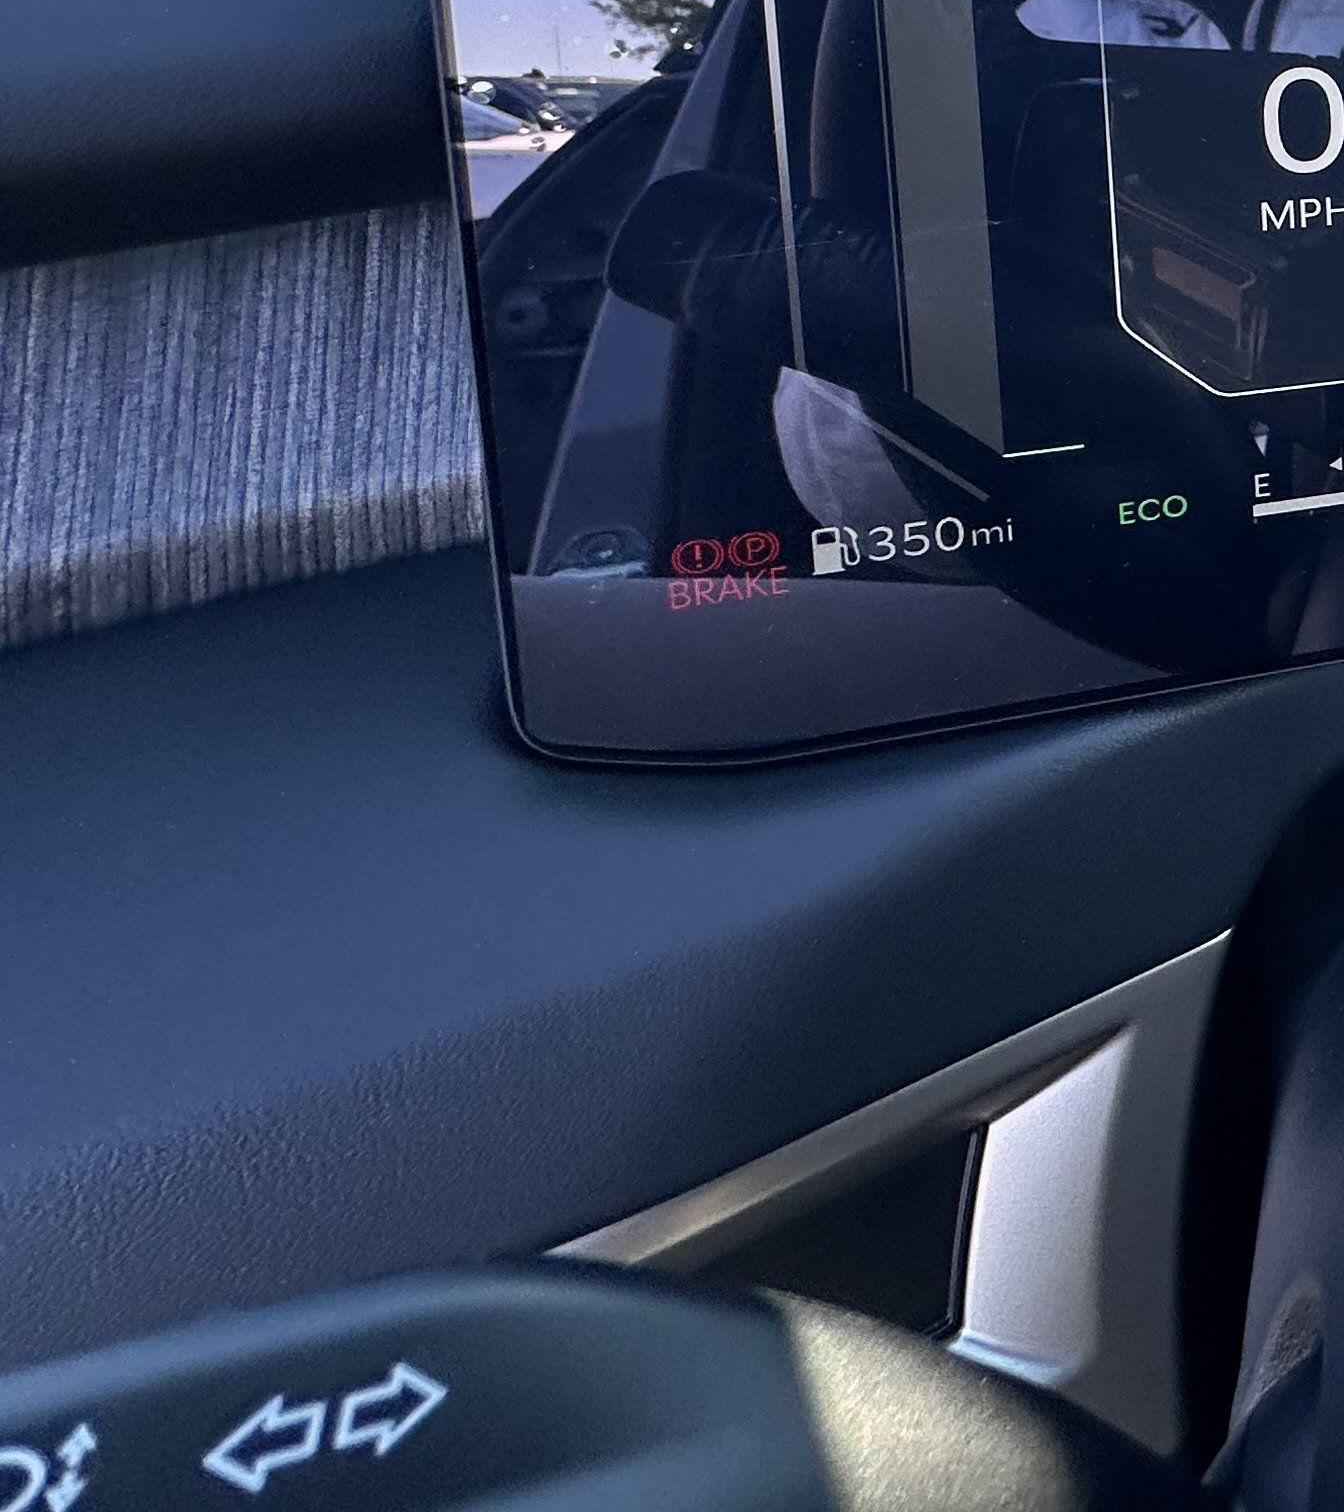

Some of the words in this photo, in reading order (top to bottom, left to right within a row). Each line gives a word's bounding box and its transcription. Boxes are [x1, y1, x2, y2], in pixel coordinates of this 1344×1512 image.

[1254, 472, 1271, 498] E
[1118, 495, 1189, 526] ECO
[667, 565, 790, 610] BRAKE
